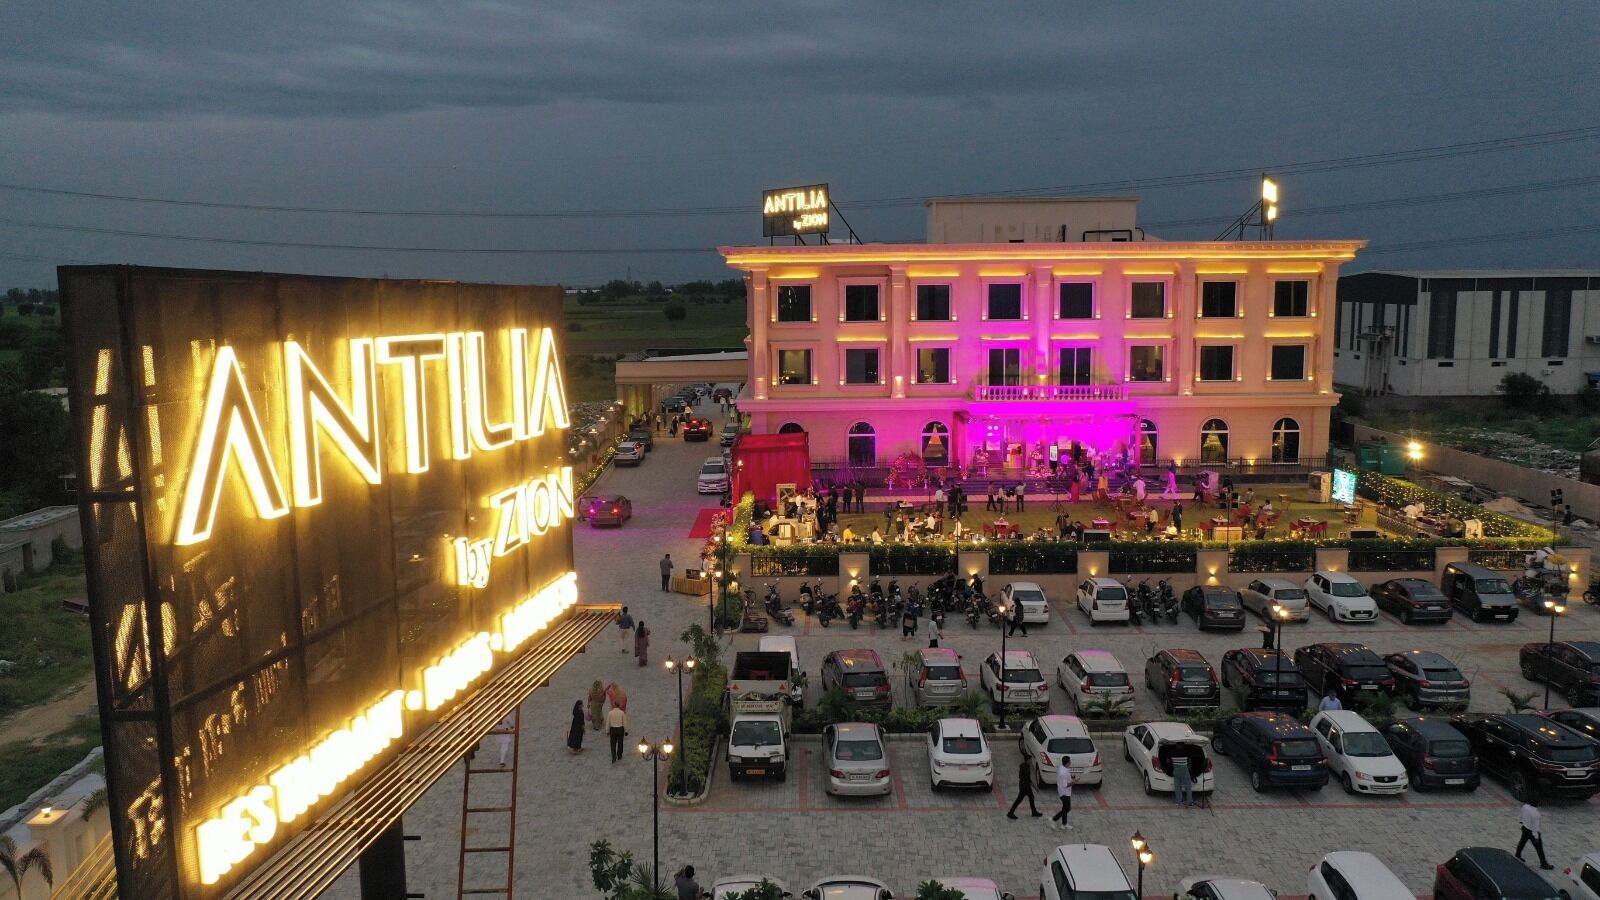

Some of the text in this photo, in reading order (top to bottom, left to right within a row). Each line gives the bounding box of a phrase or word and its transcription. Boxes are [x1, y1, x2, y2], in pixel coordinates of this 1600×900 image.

[763, 190, 826, 214] ANTILIA
[801, 213, 827, 227] ZION
[174, 327, 570, 546] ANTILIA
[453, 466, 575, 589] by ZION
